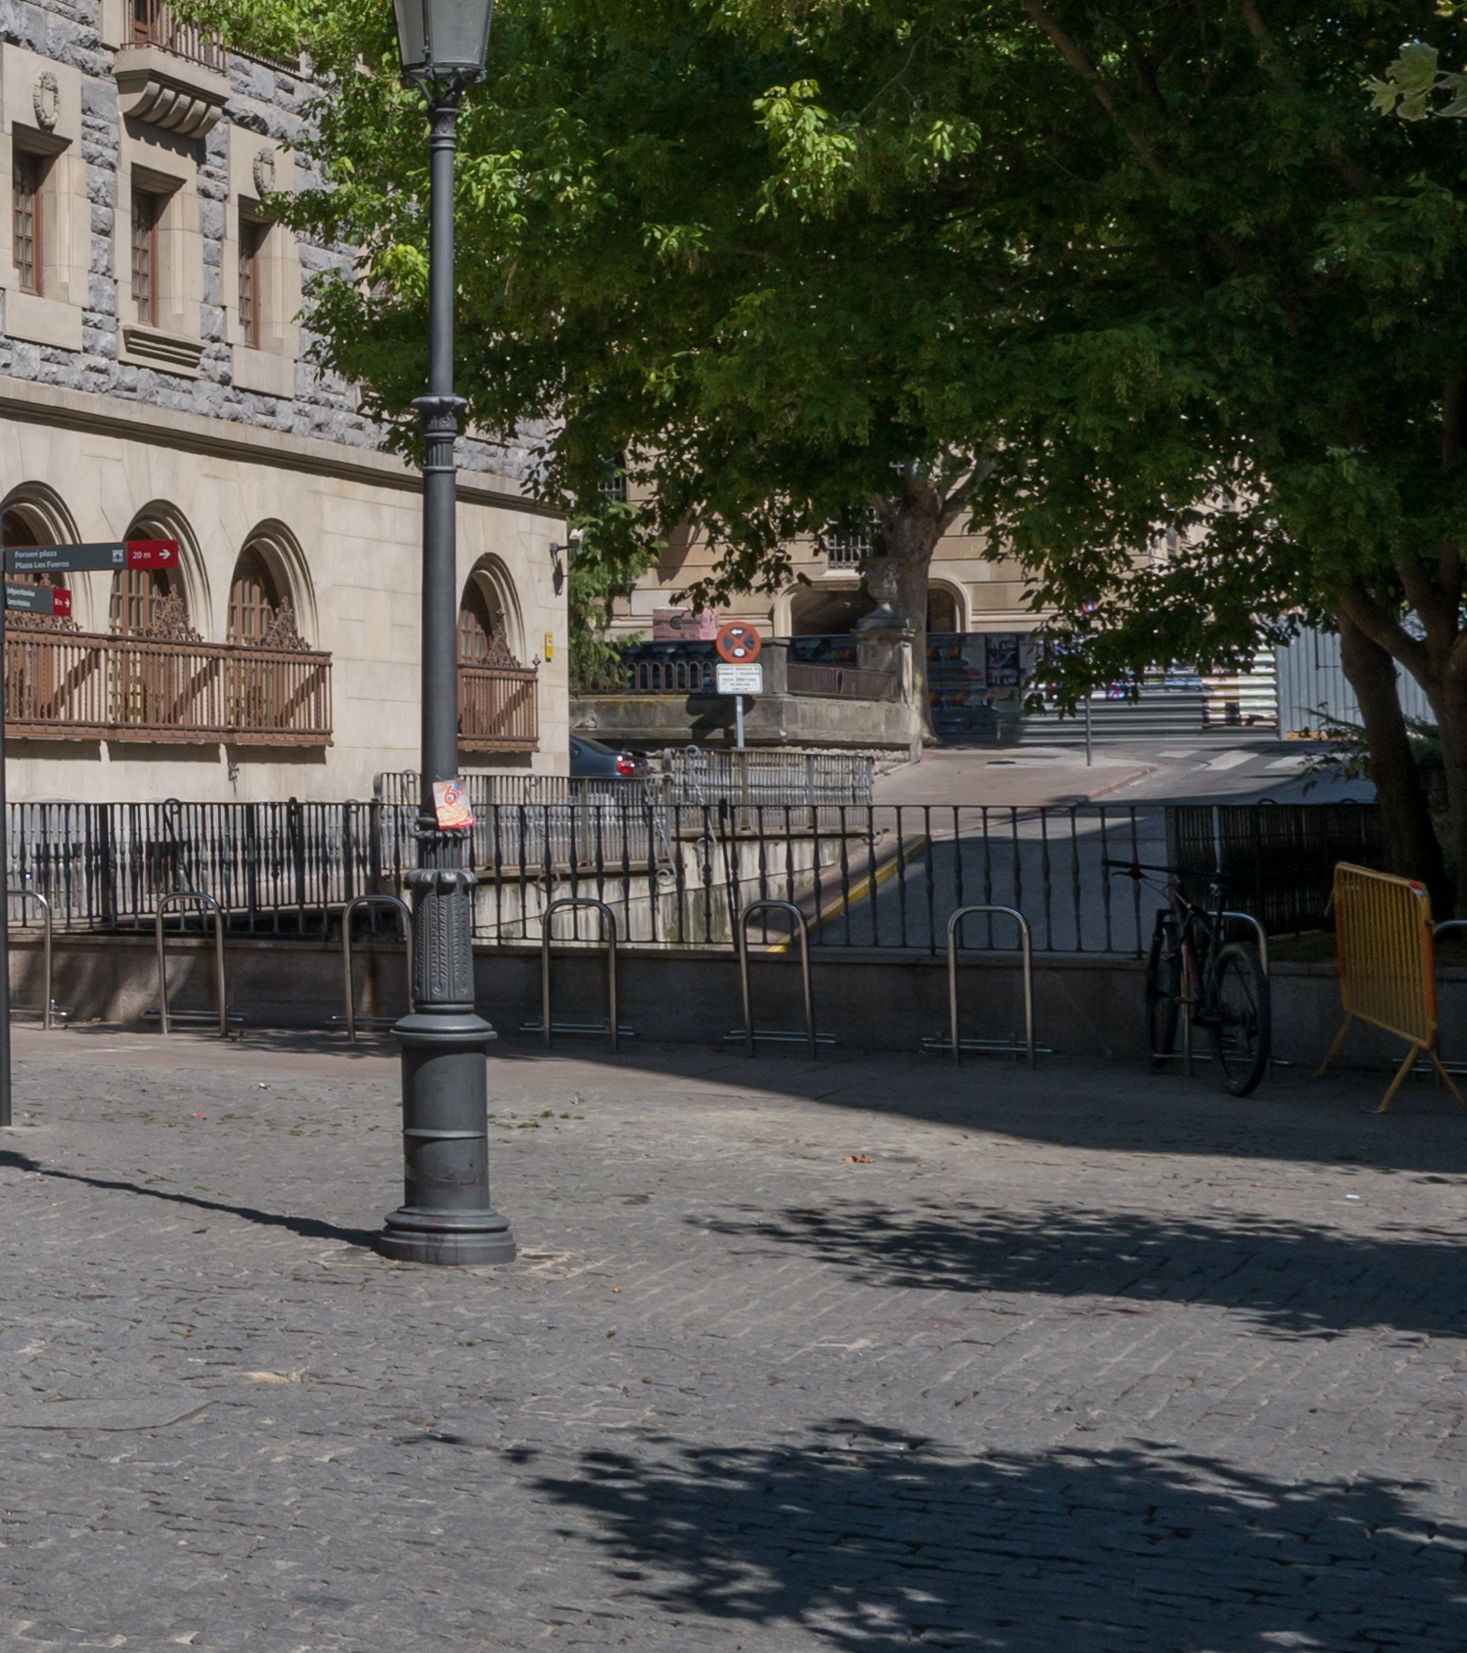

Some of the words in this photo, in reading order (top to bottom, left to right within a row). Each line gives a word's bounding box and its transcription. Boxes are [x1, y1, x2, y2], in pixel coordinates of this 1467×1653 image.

[14, 550, 38, 558] Foruen
[39, 550, 57, 558] plaza
[14, 561, 33, 569] Plaza
[47, 560, 70, 568] Fueros
